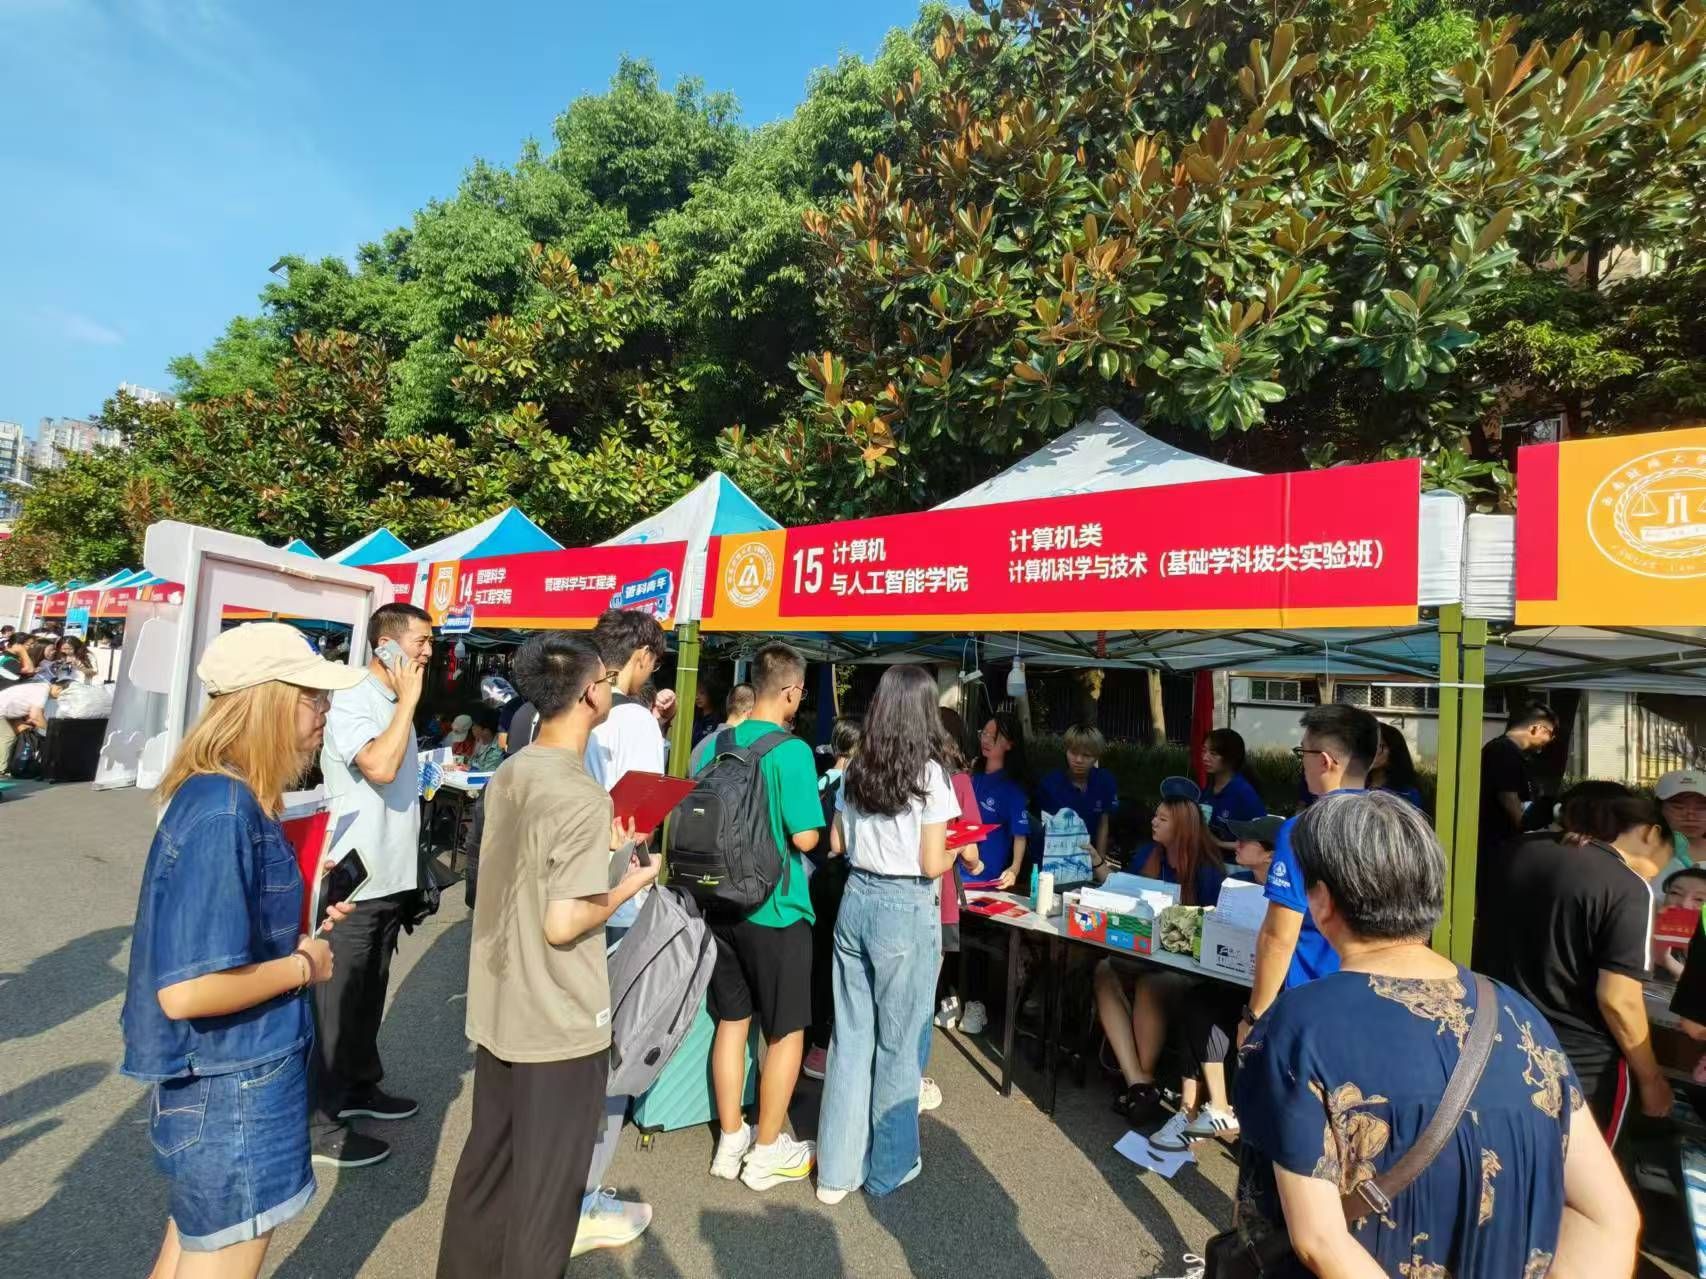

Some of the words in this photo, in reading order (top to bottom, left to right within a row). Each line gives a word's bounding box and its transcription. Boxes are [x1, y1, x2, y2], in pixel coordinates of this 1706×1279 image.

[833, 537, 887, 565] 计算机
[1009, 522, 1103, 552] 计算机类
[476, 568, 507, 584] 管理科学
[544, 574, 617, 593] 管理科学与工程类
[792, 548, 824, 594] 15
[829, 566, 969, 597] 与人工智能学院
[459, 573, 474, 603] 14
[474, 588, 513, 605] 与工程学院
